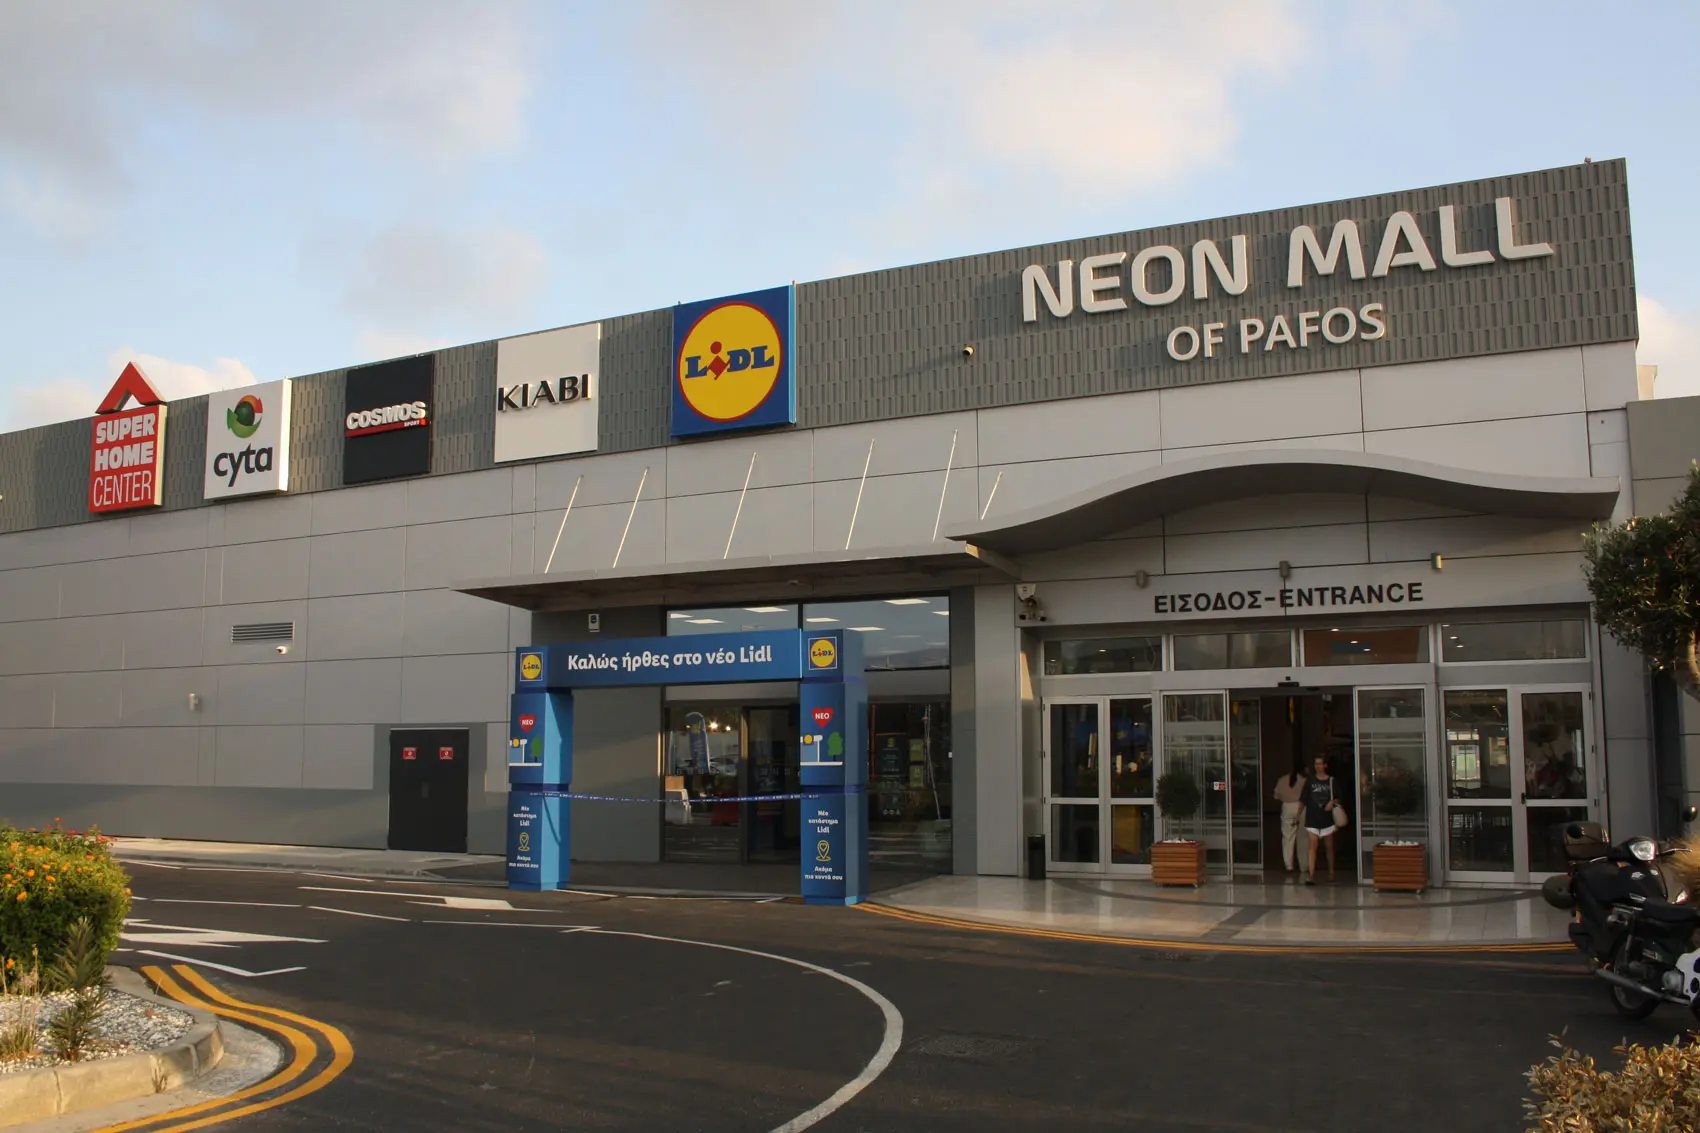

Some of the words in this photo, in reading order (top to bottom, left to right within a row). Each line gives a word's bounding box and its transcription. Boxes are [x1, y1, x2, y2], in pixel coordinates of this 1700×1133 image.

[1021, 233, 1249, 323] NEON
[1287, 196, 1555, 288] MALL
[1166, 321, 1225, 362] OF
[1239, 303, 1387, 354] PAFOS
[497, 373, 593, 412] KIABI
[95, 413, 156, 444] SUPER
[346, 401, 426, 430] COSMOS
[95, 442, 154, 472] HOME
[213, 444, 273, 487] cyta
[93, 471, 152, 507] CENTER
[568, 654, 618, 671] Καλώς
[622, 651, 669, 672] ήρθες
[673, 652, 702, 666] στο
[706, 648, 736, 664] νέο
[740, 645, 772, 663] Lidl
[817, 826, 830, 834] Lidl
